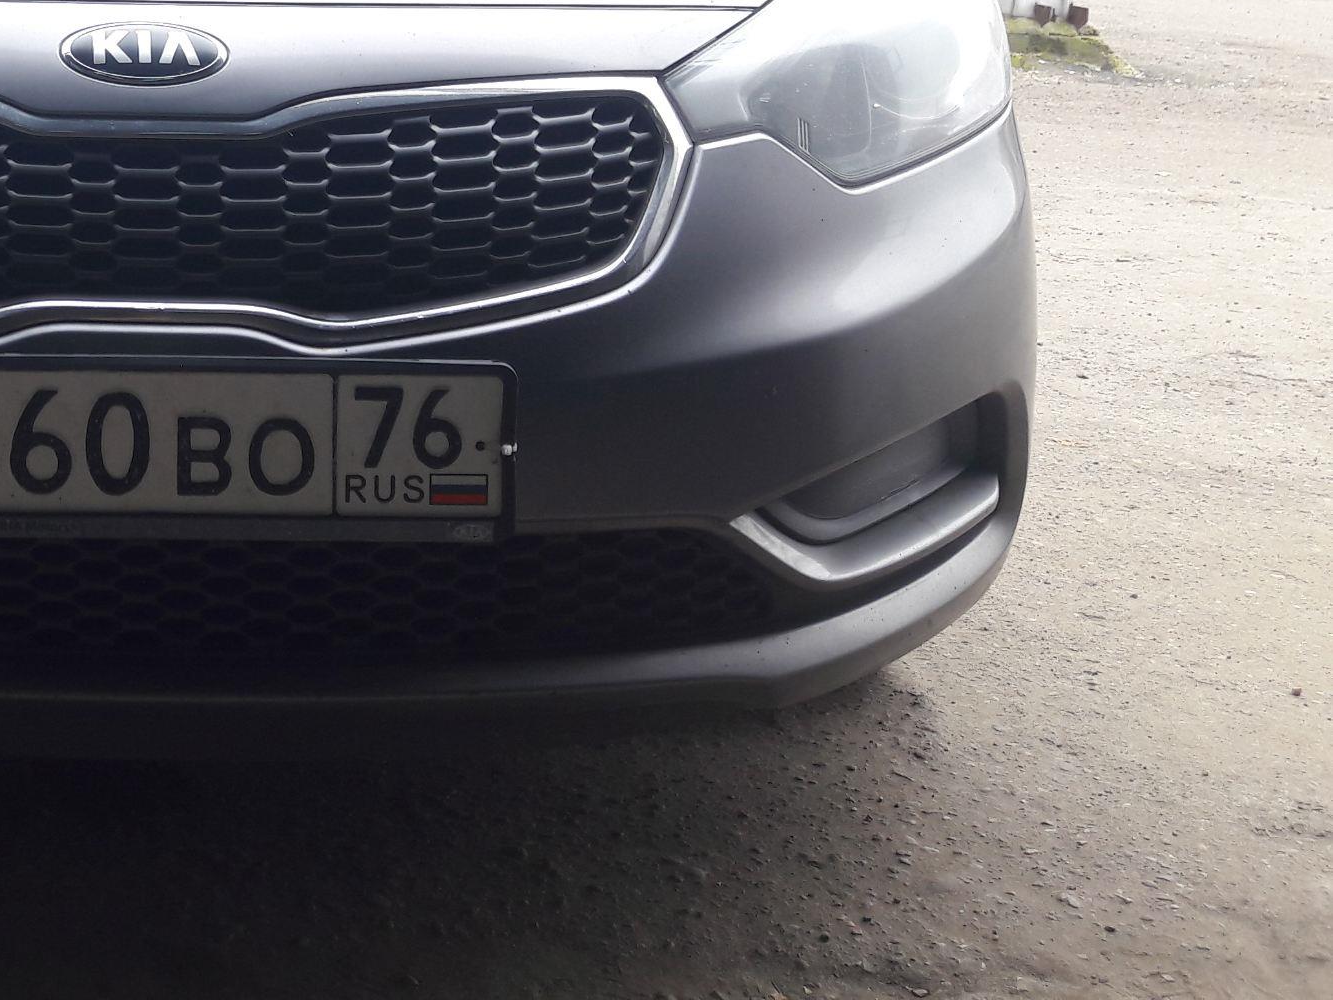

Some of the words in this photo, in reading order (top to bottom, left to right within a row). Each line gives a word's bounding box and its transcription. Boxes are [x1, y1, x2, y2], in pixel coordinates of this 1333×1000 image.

[89, 28, 201, 66] KIA
[354, 386, 463, 470] 76
[344, 473, 425, 505] RUS
